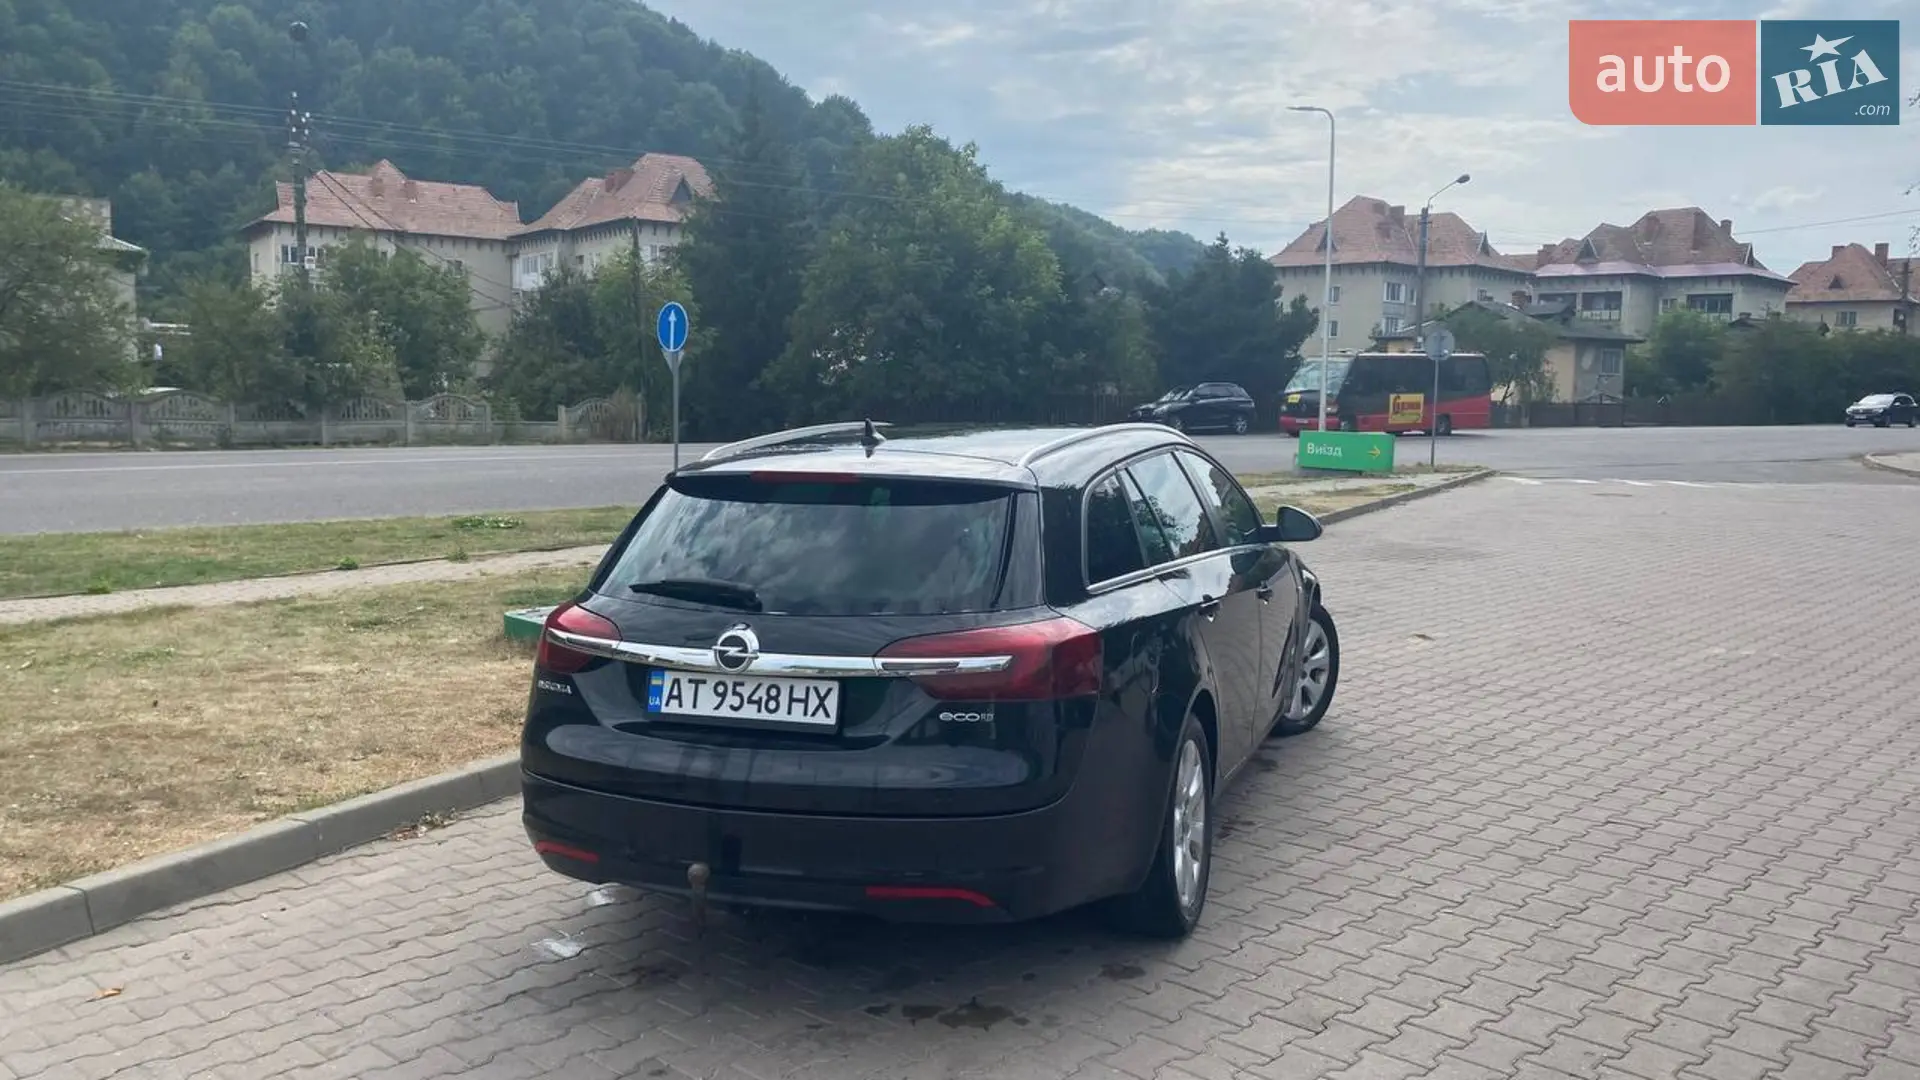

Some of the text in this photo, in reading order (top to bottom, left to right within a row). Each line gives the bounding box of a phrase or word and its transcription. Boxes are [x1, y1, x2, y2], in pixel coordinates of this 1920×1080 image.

[1307, 442, 1342, 457] Виїзд
[649, 695, 661, 707] UA
[664, 677, 833, 719] AT 9548 HX
